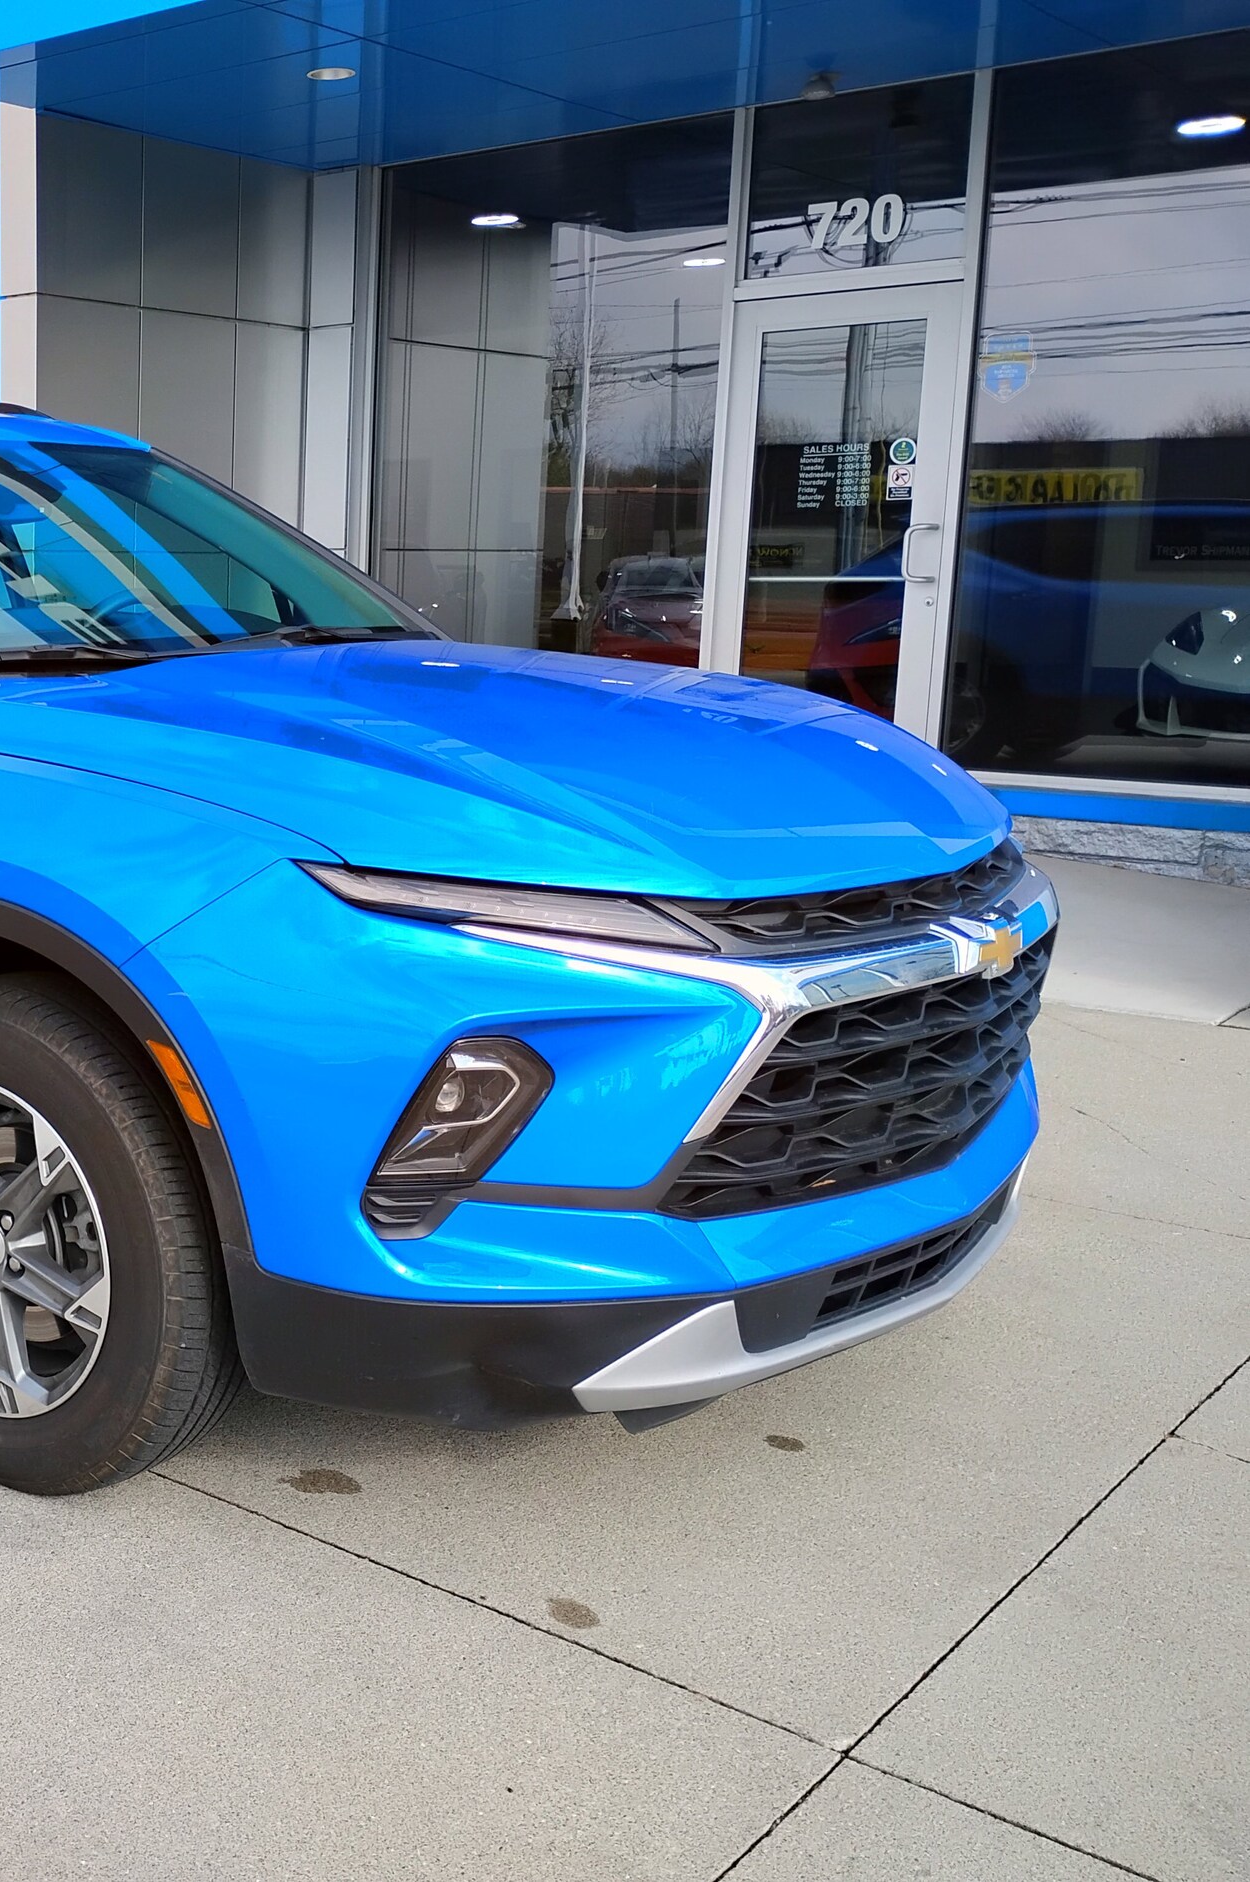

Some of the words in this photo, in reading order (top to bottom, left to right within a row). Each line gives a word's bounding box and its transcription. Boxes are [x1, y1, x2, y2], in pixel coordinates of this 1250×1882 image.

[807, 193, 904, 250] 720
[803, 445, 834, 454] SALES
[836, 442, 870, 452] HOURS
[838, 455, 871, 463] 9:00-7:00
[800, 464, 824, 472] Tuesday
[799, 471, 835, 479] Wednesday
[799, 479, 827, 487] Thursday
[837, 477, 869, 485] 9:00-7:00
[798, 486, 817, 494] Friday
[836, 485, 869, 493] 9:00-6:00
[798, 494, 824, 502] Saturday
[797, 501, 820, 509] Sunday
[835, 499, 867, 507] CLOSED
